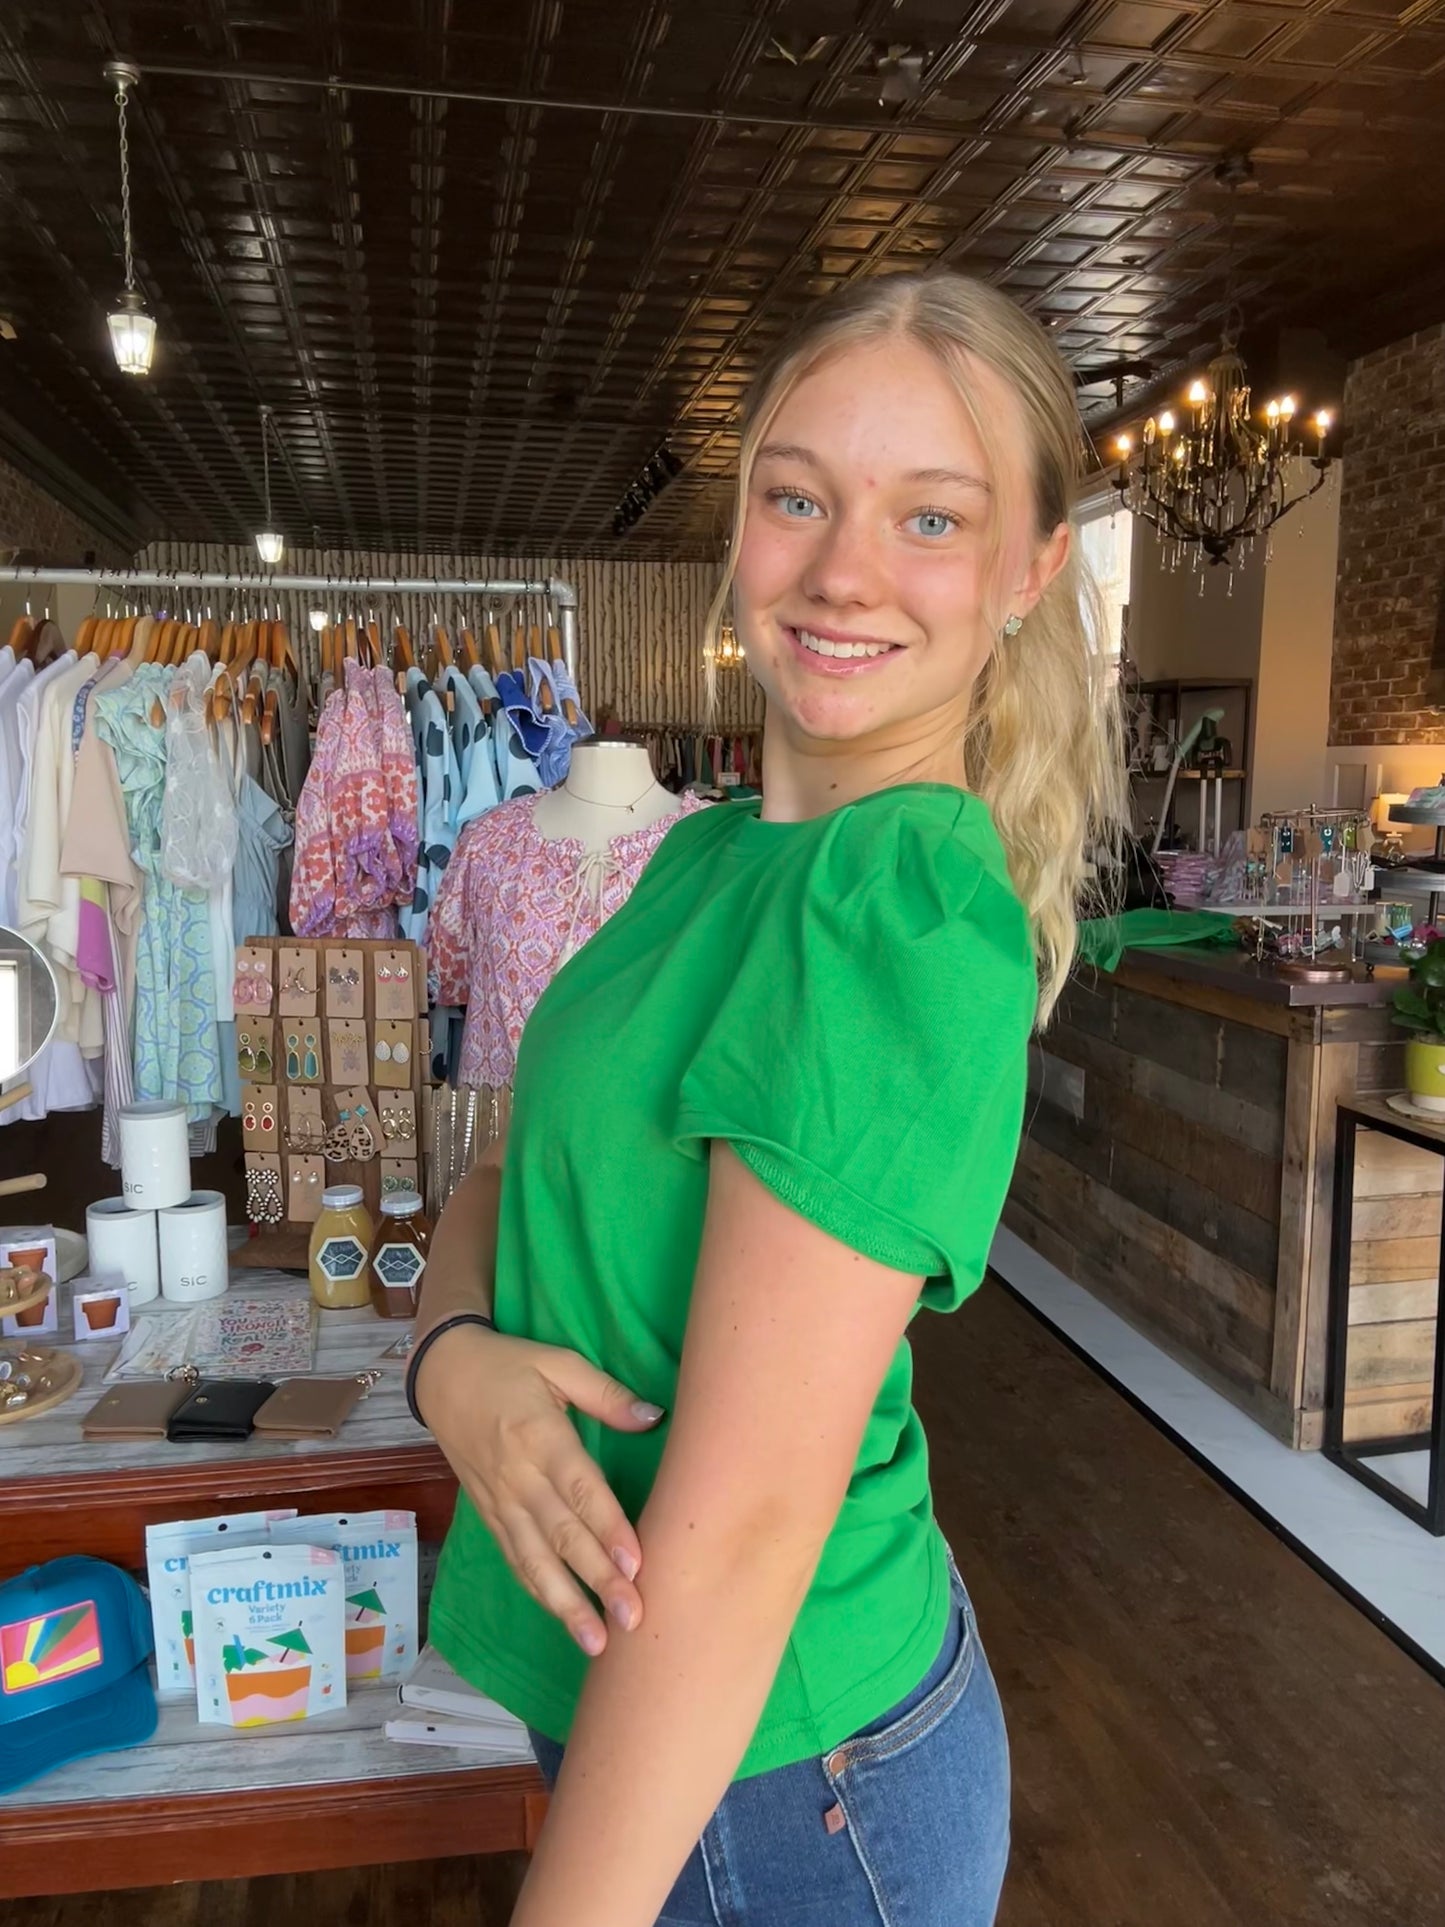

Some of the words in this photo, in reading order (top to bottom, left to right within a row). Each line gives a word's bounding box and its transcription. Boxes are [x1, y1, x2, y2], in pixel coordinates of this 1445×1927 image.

[124, 1181, 144, 1194] SIC
[180, 1275, 208, 1287] SIC
[207, 1575, 328, 1605] craftmix
[248, 1602, 286, 1614] Variety
[248, 1614, 257, 1624] 6
[257, 1612, 283, 1623] Pack
